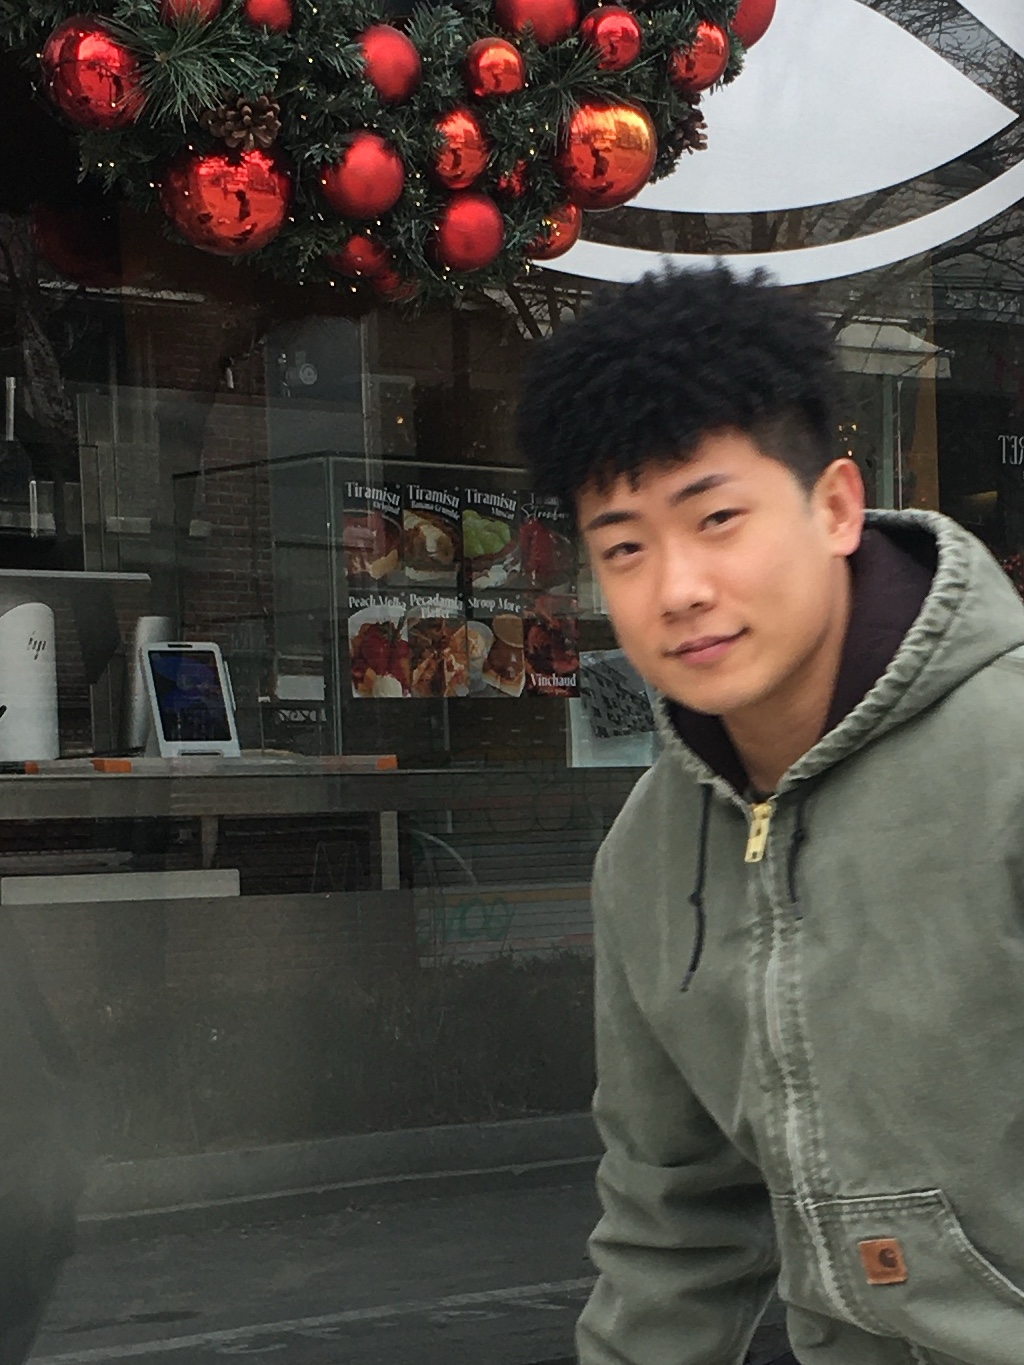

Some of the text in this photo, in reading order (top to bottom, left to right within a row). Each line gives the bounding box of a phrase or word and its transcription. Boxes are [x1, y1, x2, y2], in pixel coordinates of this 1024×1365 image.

[345, 481, 400, 506] Tiramisu
[407, 484, 460, 508] Tiramisu
[464, 488, 517, 512] Tiramisu
[348, 594, 376, 608] Peach
[530, 673, 577, 687] Vinchaud
